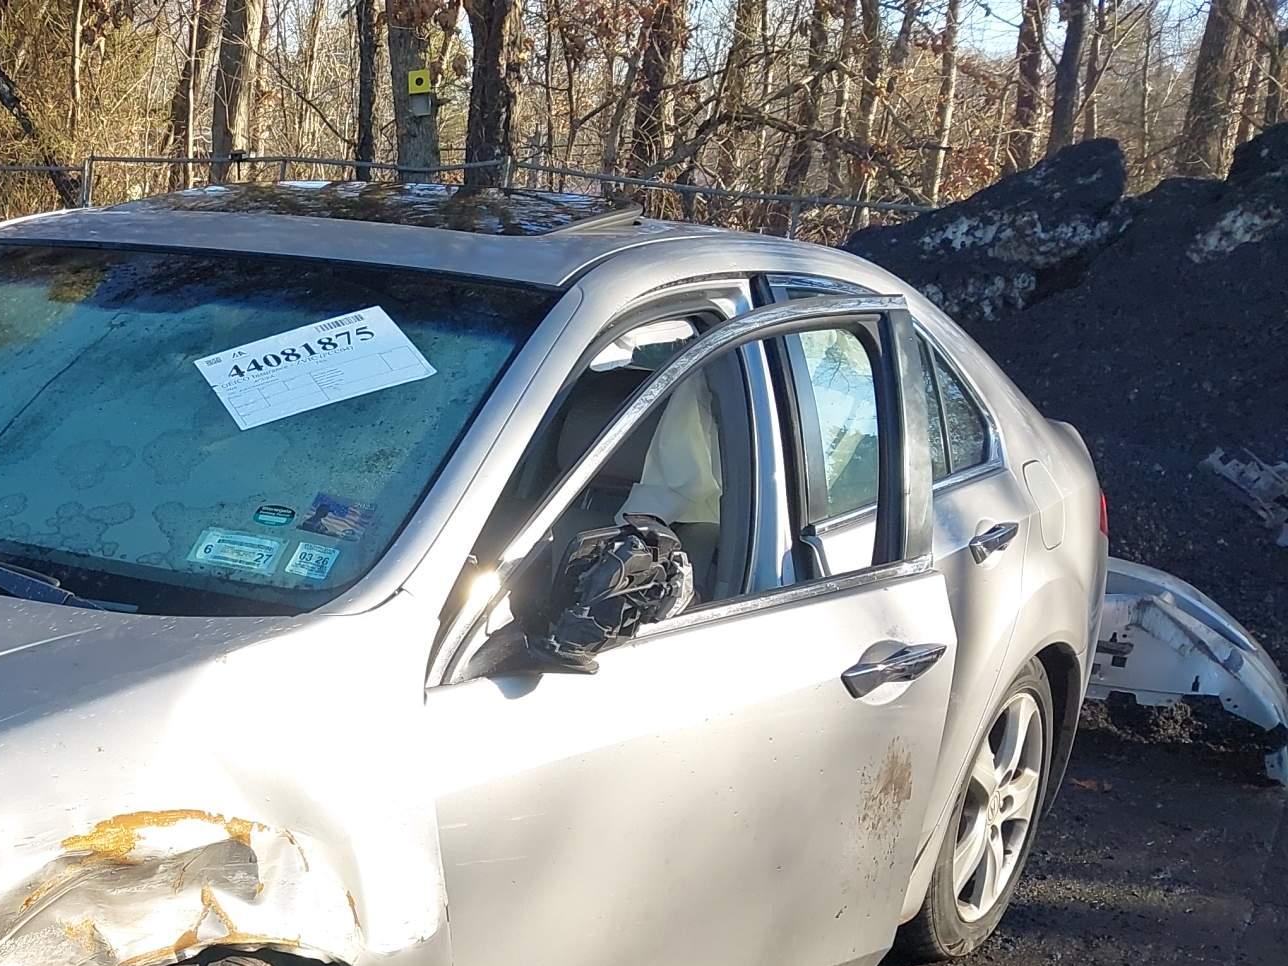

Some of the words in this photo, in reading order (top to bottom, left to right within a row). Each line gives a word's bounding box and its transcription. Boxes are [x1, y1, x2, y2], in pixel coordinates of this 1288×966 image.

[228, 325, 375, 379] 44081875
[203, 544, 214, 554] 6
[254, 552, 273, 564] 27
[299, 551, 314, 562] 03
[314, 555, 330, 566] 26
